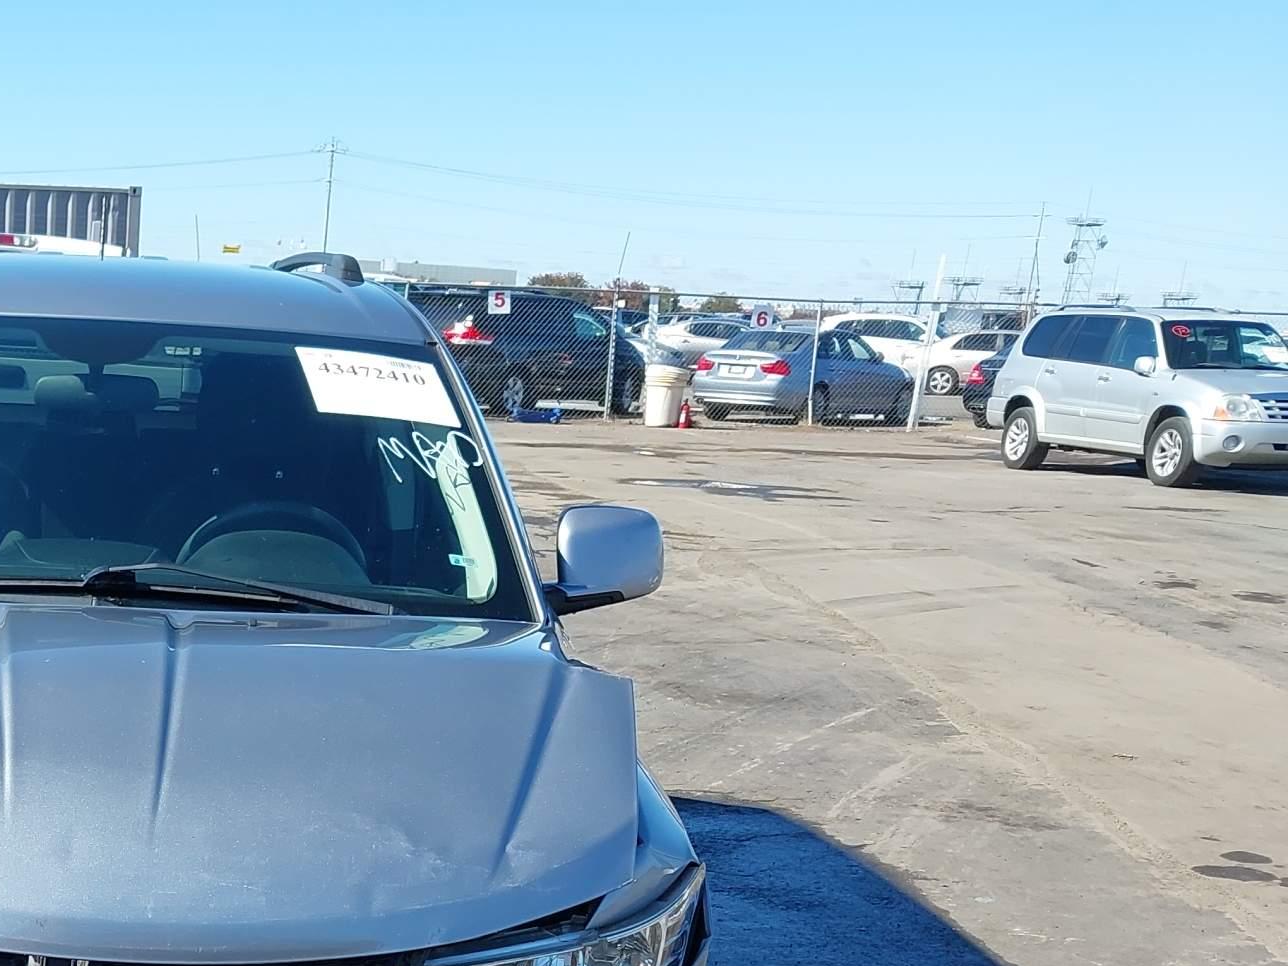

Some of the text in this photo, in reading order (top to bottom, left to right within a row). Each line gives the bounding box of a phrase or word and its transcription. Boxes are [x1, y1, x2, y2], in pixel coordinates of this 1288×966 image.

[494, 292, 506, 307] 5
[756, 311, 768, 327] 6
[318, 361, 427, 386] 43472410
